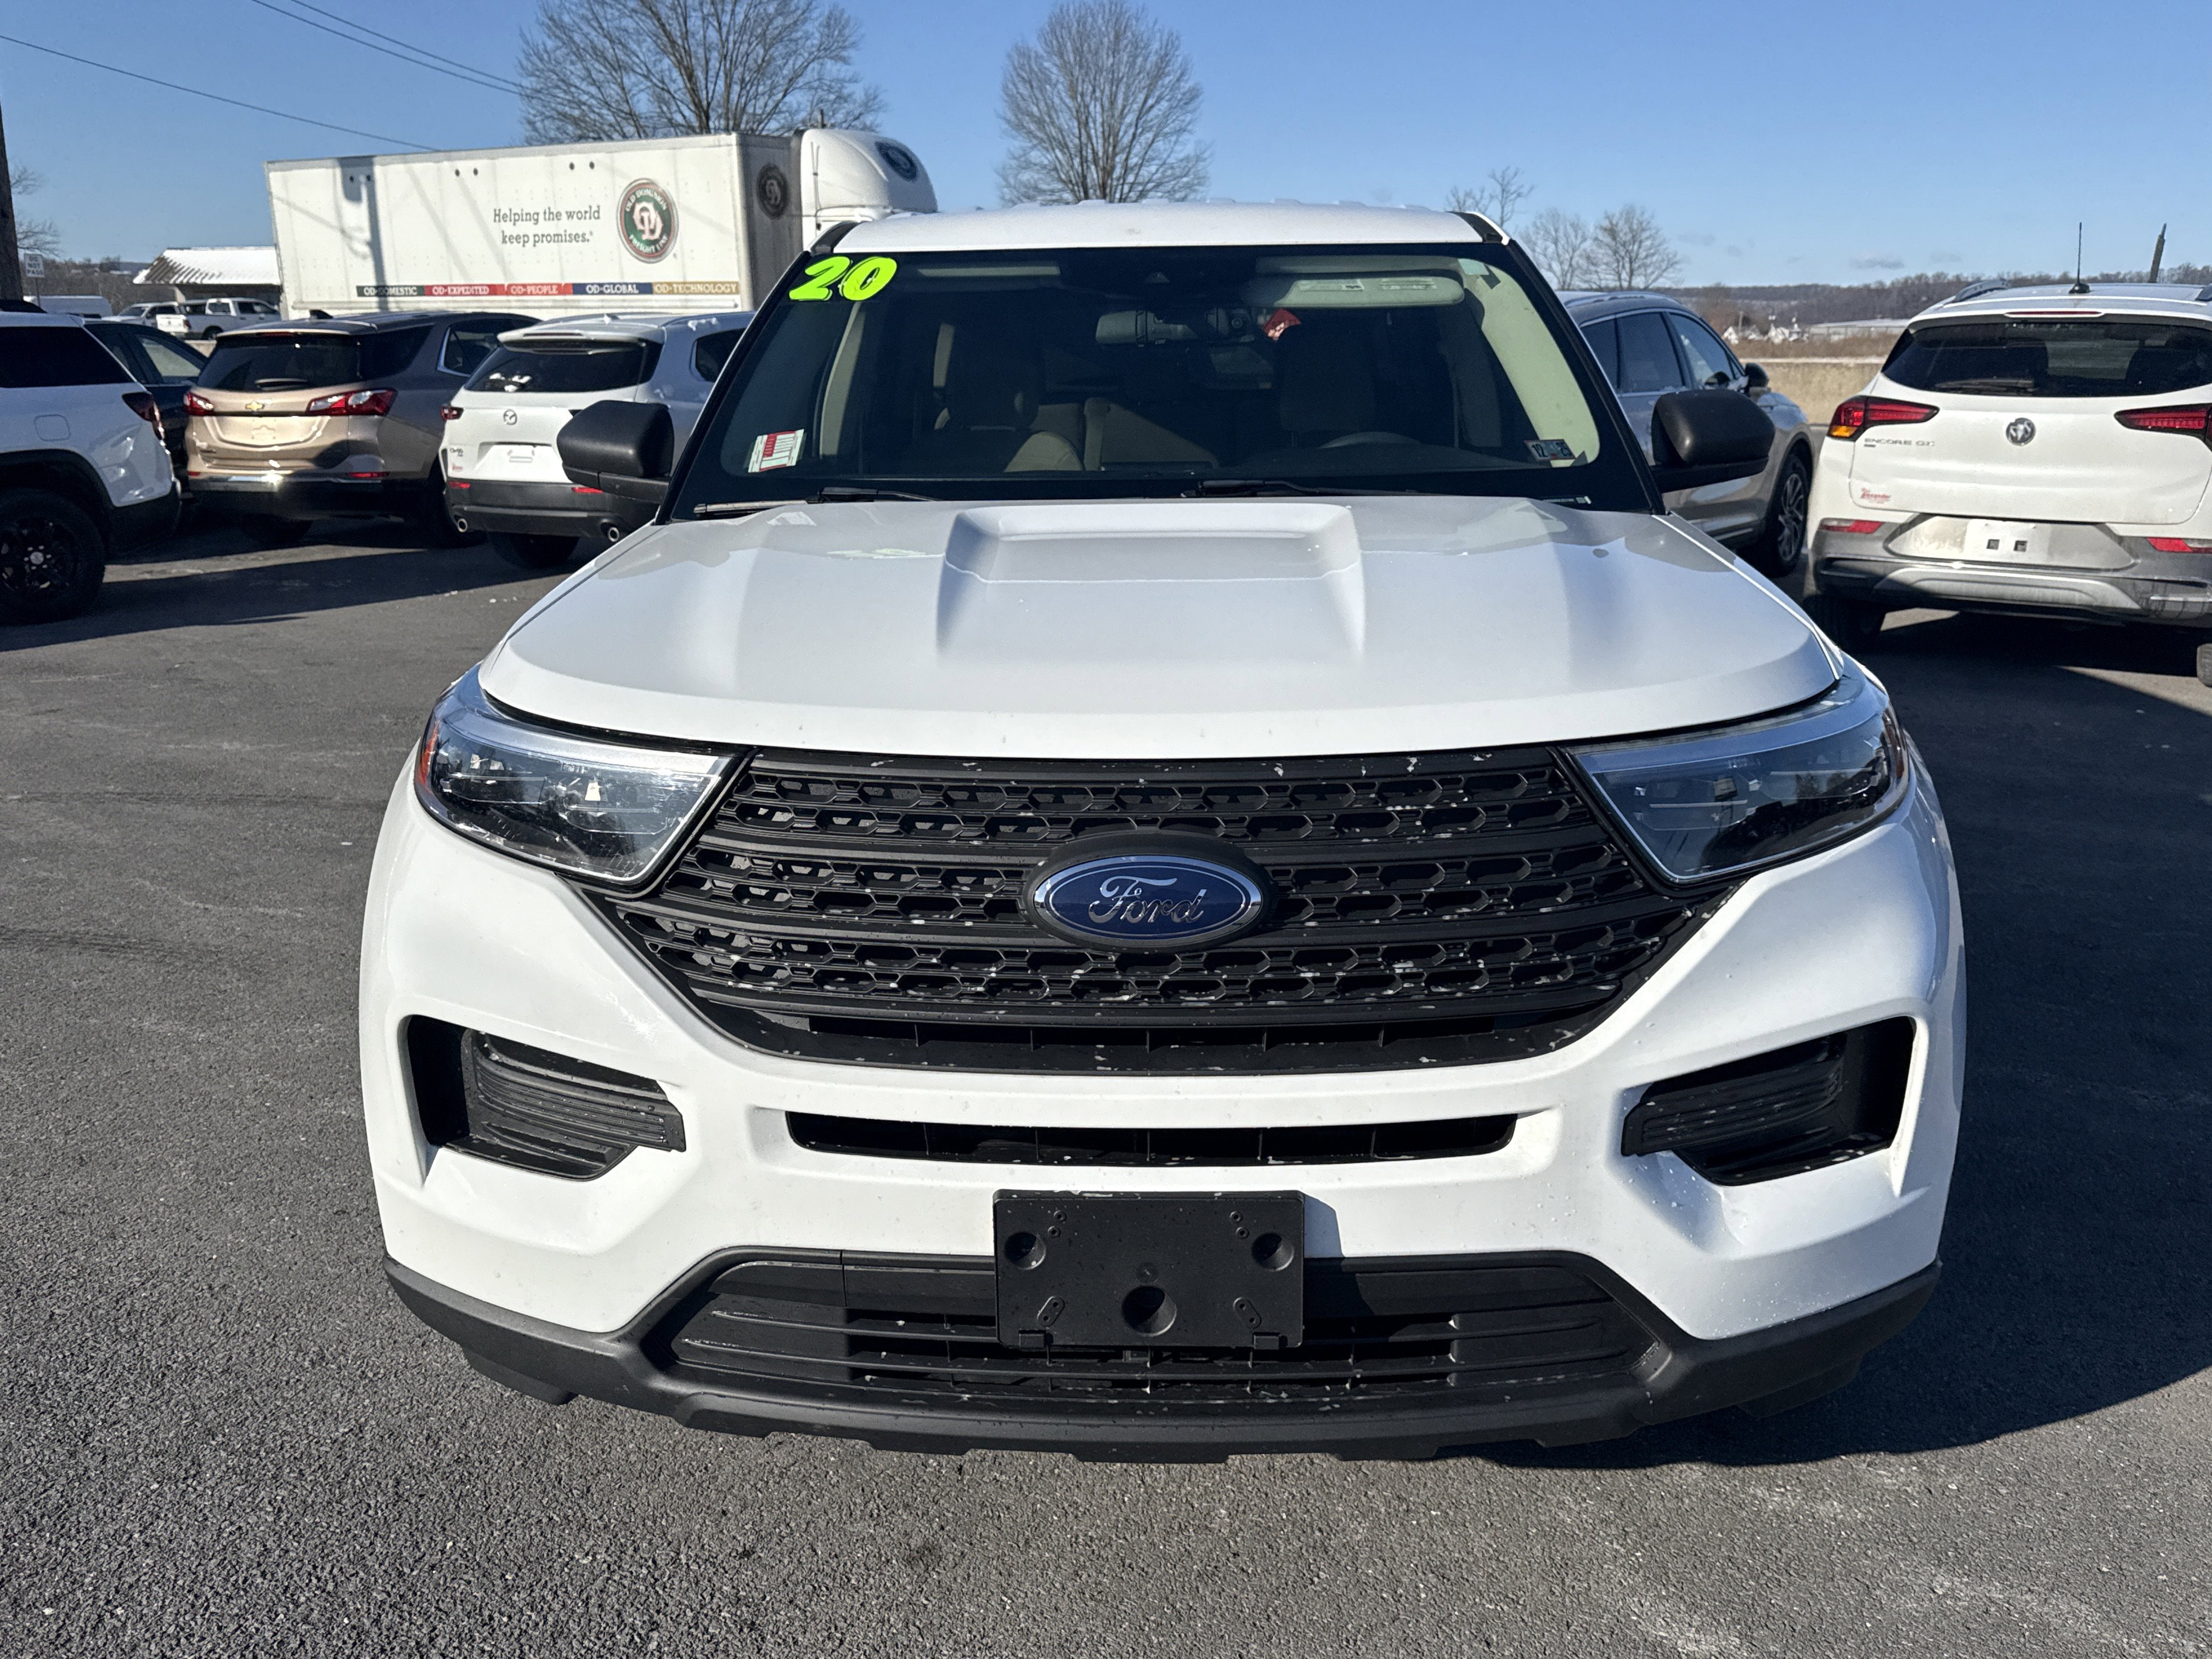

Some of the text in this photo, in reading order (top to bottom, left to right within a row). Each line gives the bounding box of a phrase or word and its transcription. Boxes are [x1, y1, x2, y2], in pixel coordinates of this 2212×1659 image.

[493, 205, 601, 226] Helping the world
[501, 230, 529, 247] keep
[789, 256, 897, 301] 20
[1531, 443, 1549, 458] 12
[1088, 876, 1207, 924] Ford
